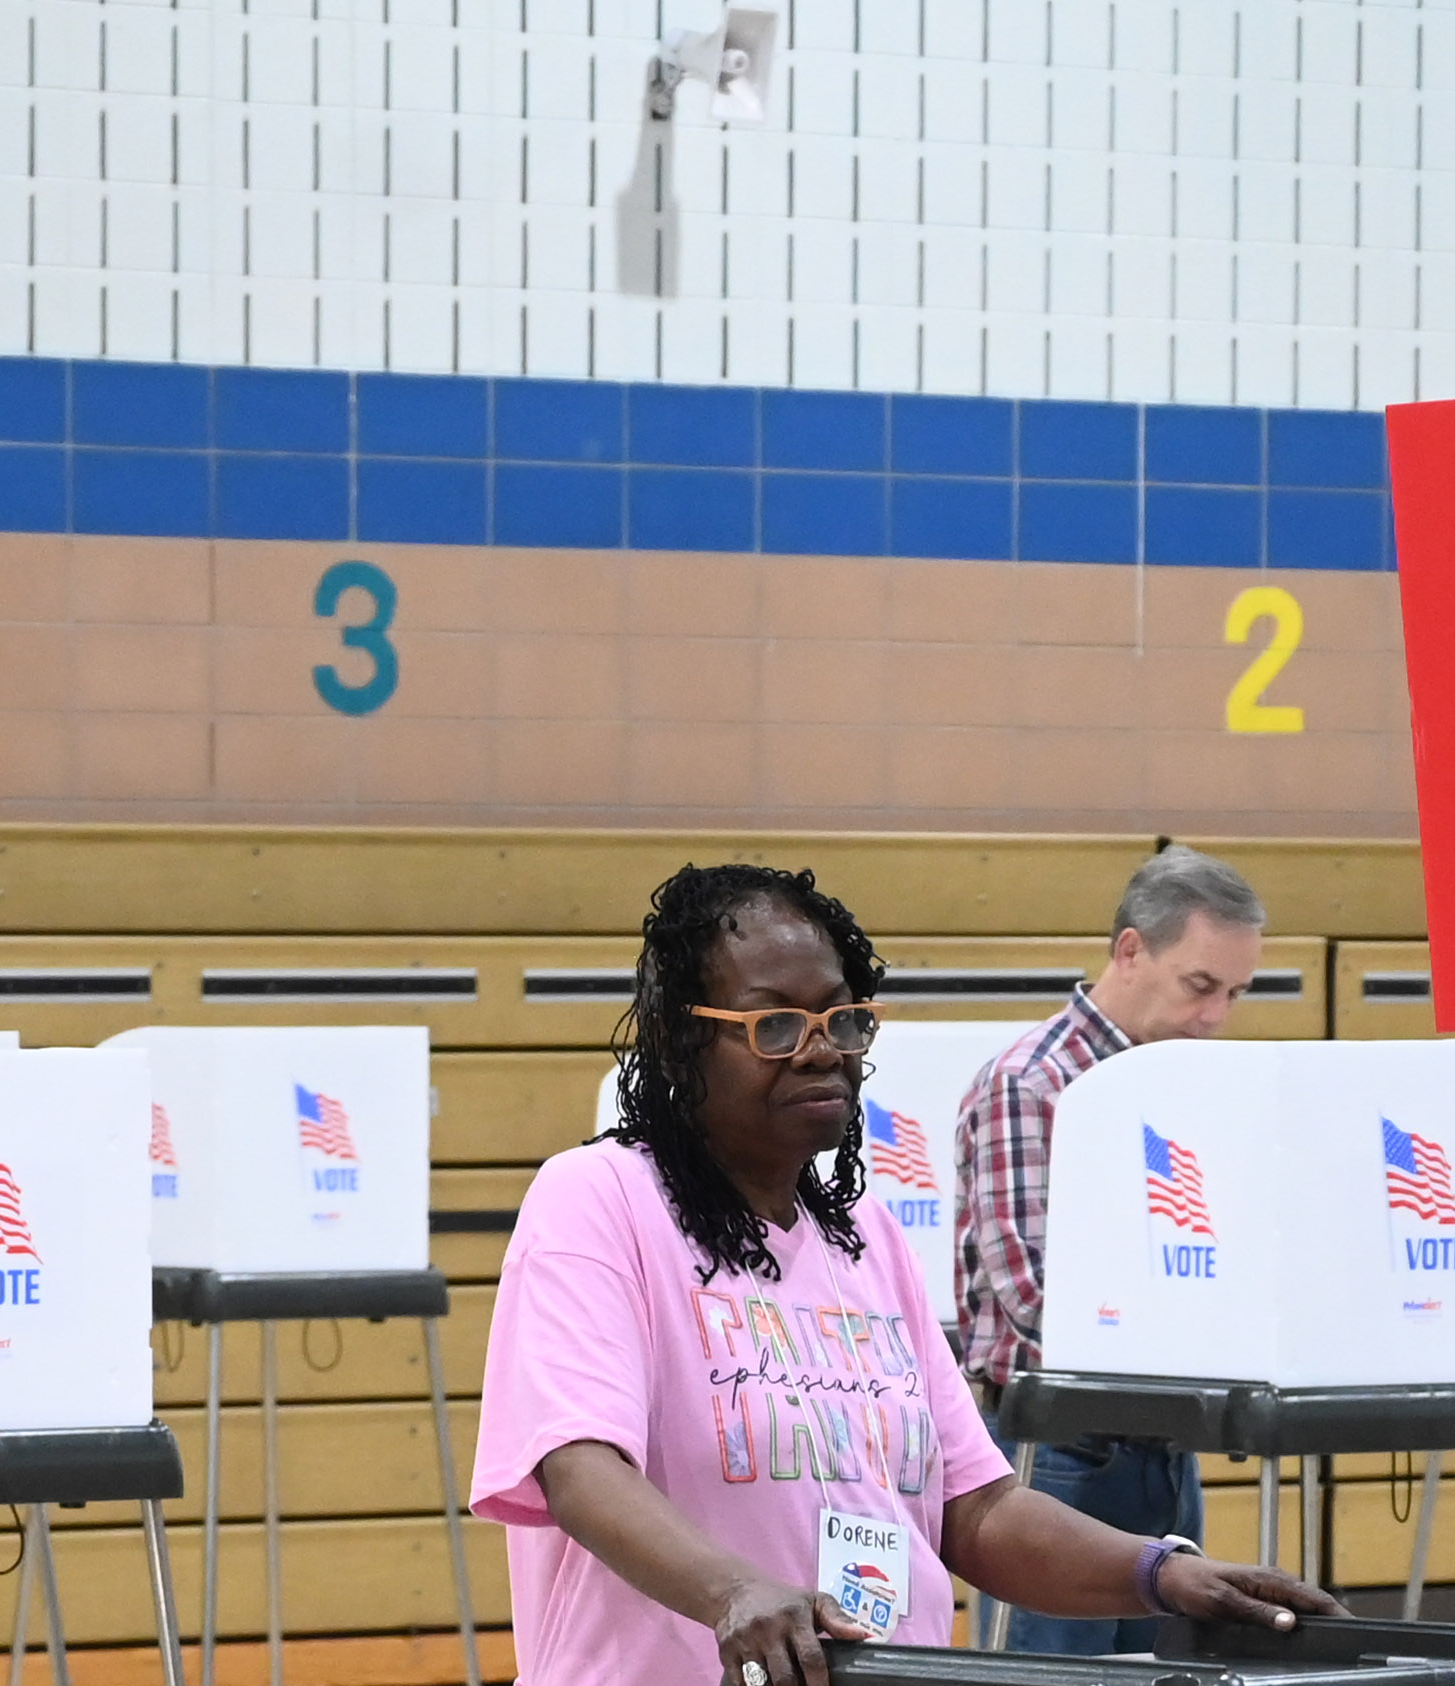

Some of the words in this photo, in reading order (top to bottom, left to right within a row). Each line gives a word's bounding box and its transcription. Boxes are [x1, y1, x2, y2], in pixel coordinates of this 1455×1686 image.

[313, 560, 398, 717] 3
[1226, 586, 1304, 732] 2
[313, 1168, 358, 1192] VOTE
[1163, 1244, 1216, 1278] VOTE
[710, 1347, 891, 1409] ephesians
